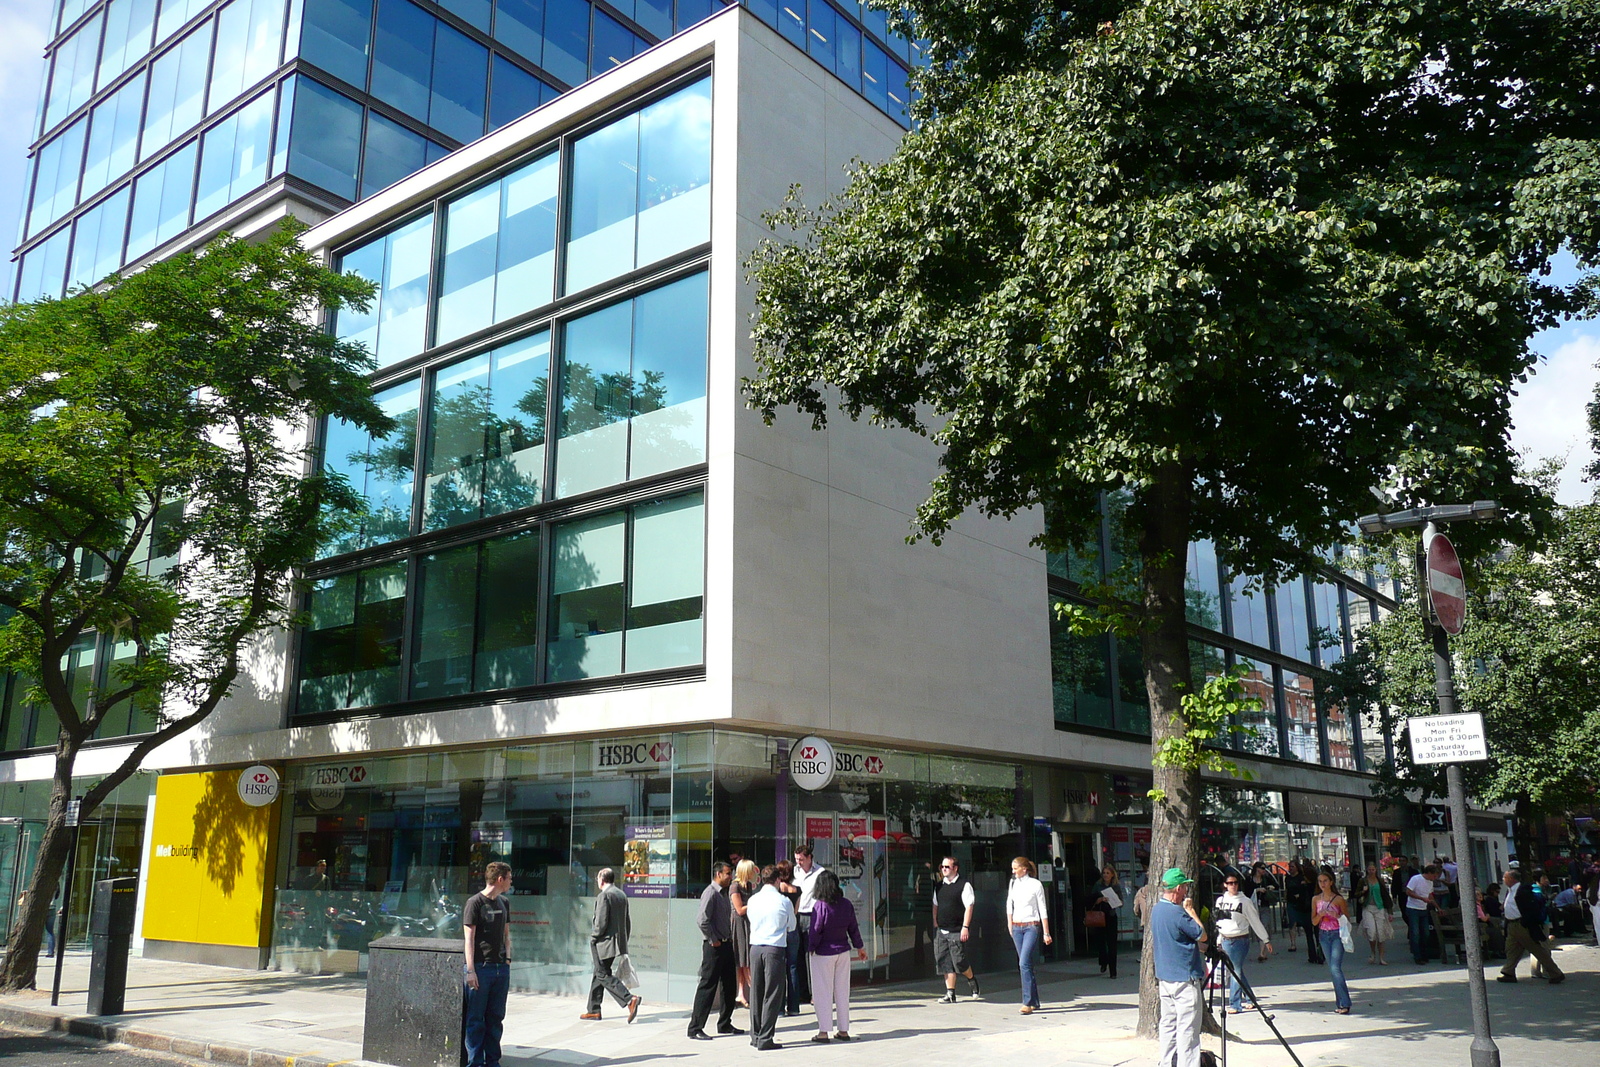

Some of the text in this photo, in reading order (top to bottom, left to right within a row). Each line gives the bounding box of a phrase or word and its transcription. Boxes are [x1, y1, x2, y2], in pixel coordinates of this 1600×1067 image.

[598, 743, 647, 766] HSBC
[835, 752, 863, 773] SBC
[316, 766, 349, 785] HSBC
[793, 761, 827, 774] HSBC
[245, 783, 275, 796] HSBC
